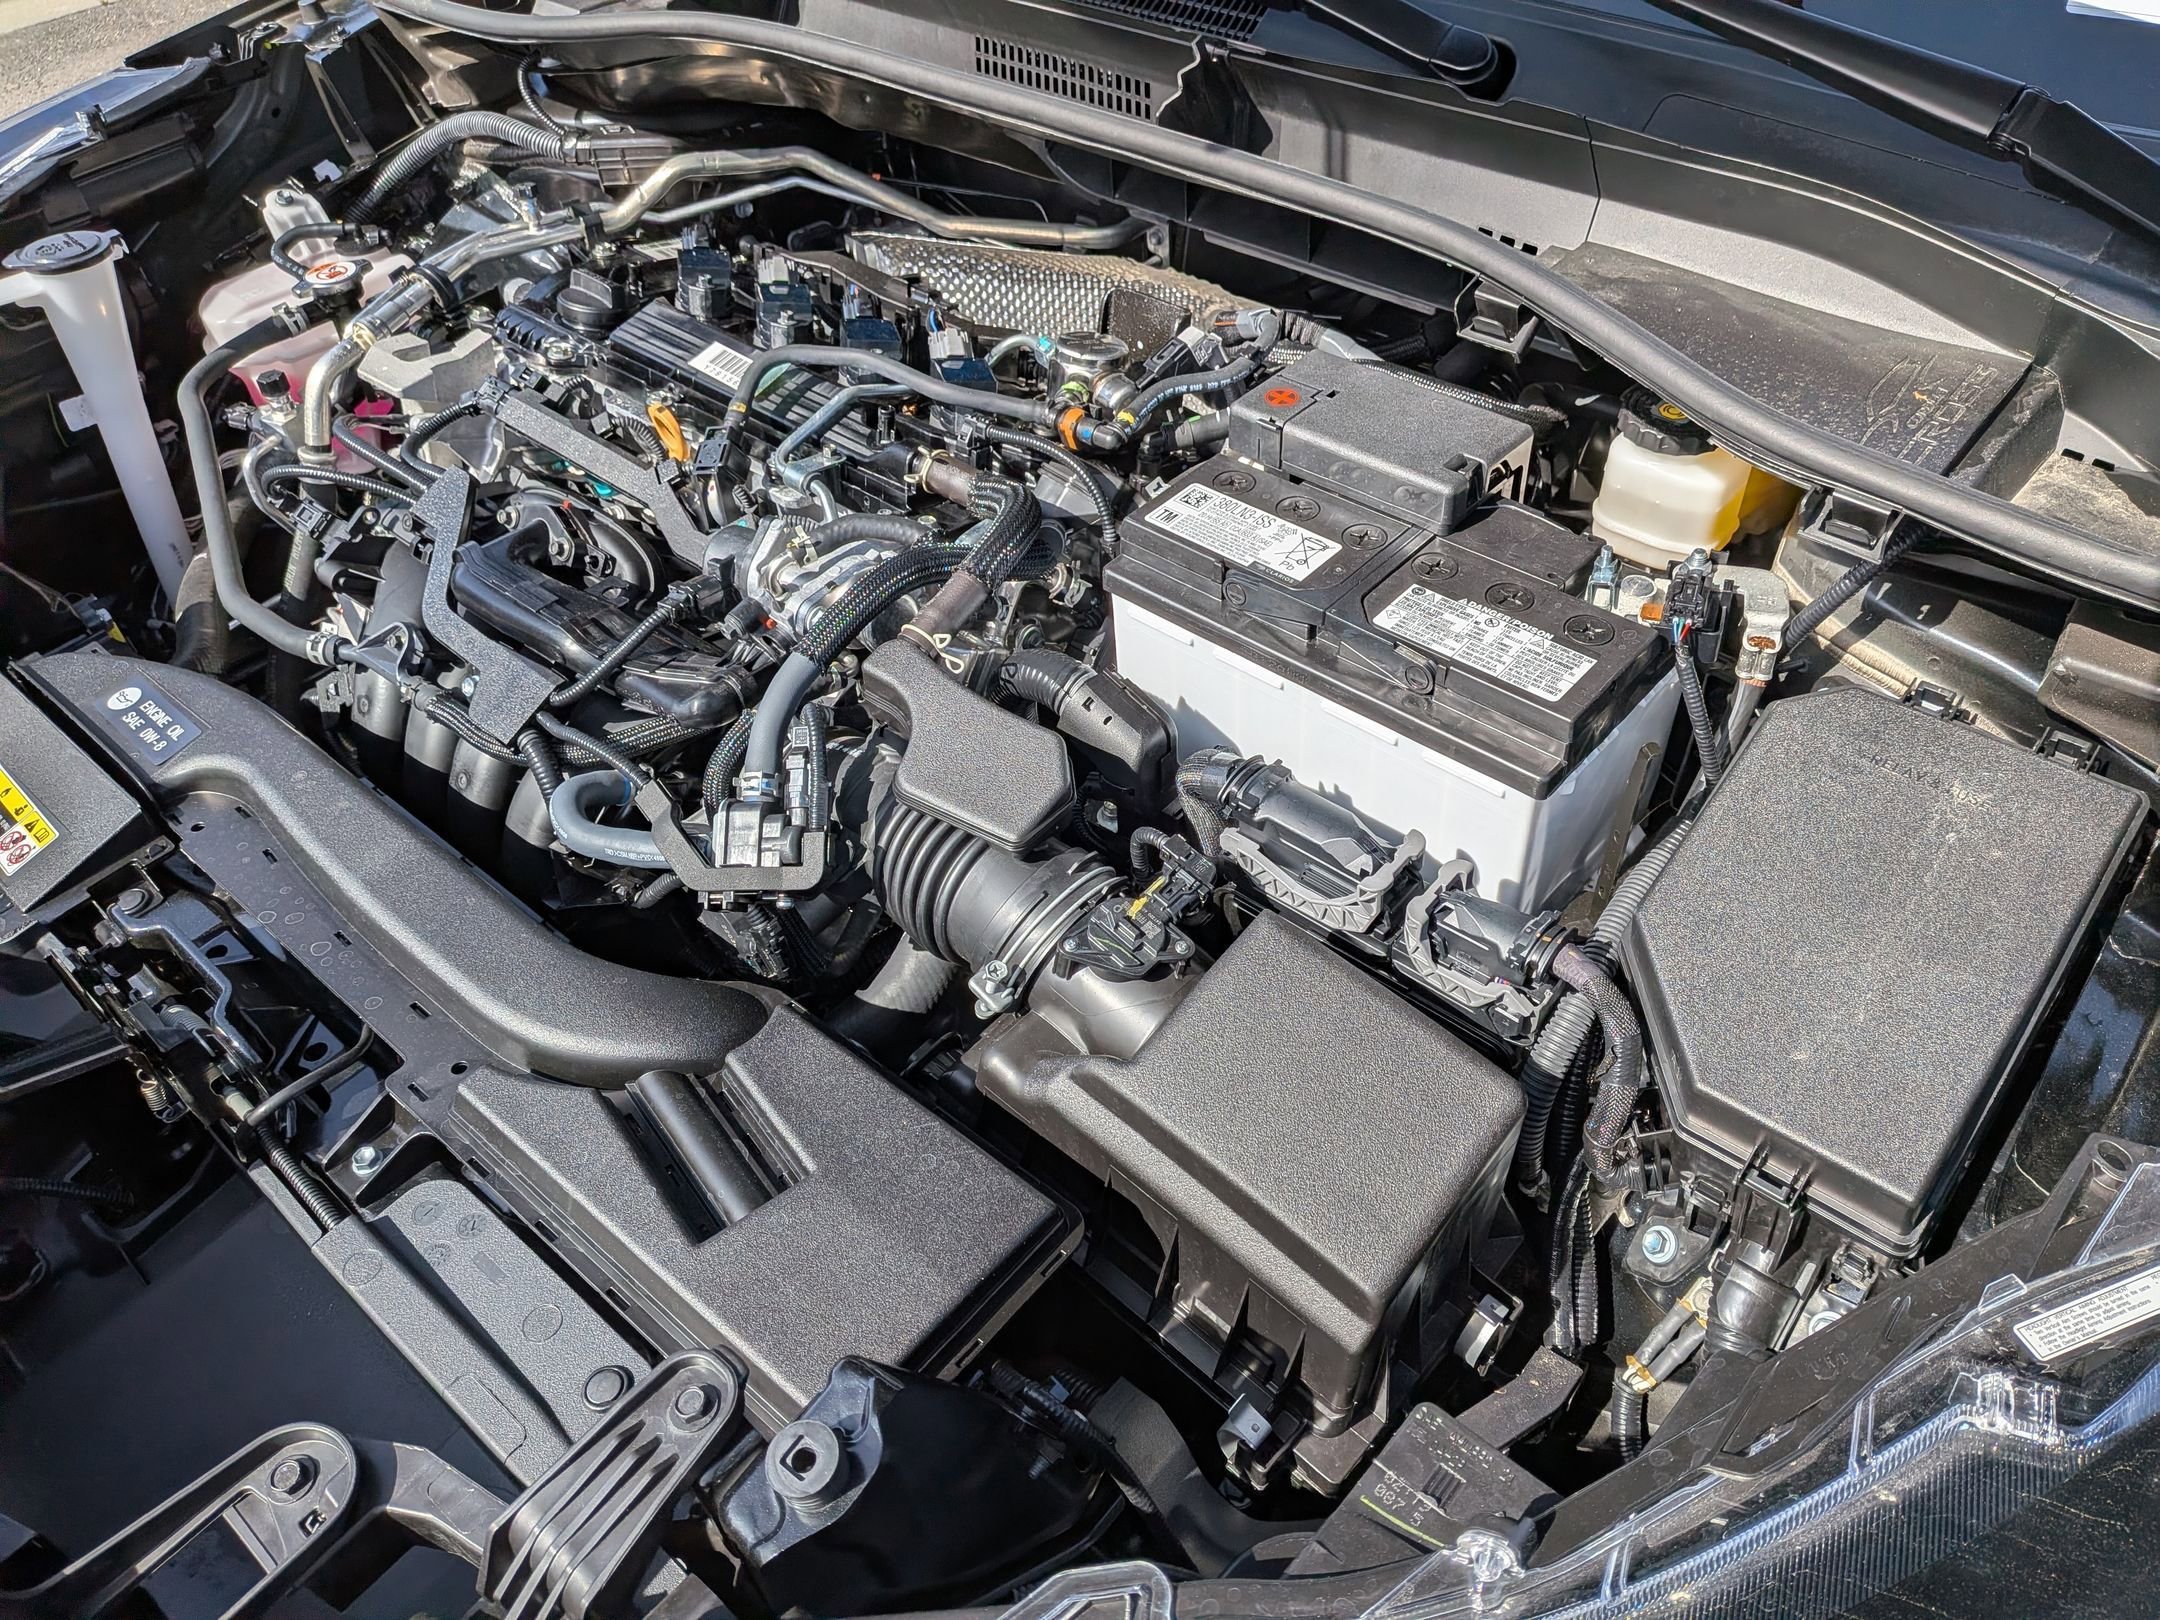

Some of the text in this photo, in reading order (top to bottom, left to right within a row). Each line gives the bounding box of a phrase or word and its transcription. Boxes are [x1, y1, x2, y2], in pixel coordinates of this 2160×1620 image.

[1152, 508, 1179, 523] TM
[1211, 496, 1278, 528] 380LN3-ISS
[1265, 568, 1295, 584] CLARIOS
[1277, 560, 1297, 570] Pb
[1467, 600, 1555, 640] DANGER/POISON
[122, 711, 168, 752] SAE 0W-8
[139, 700, 185, 742] ENGINE OIL
[1871, 754, 1928, 783] RELAY
